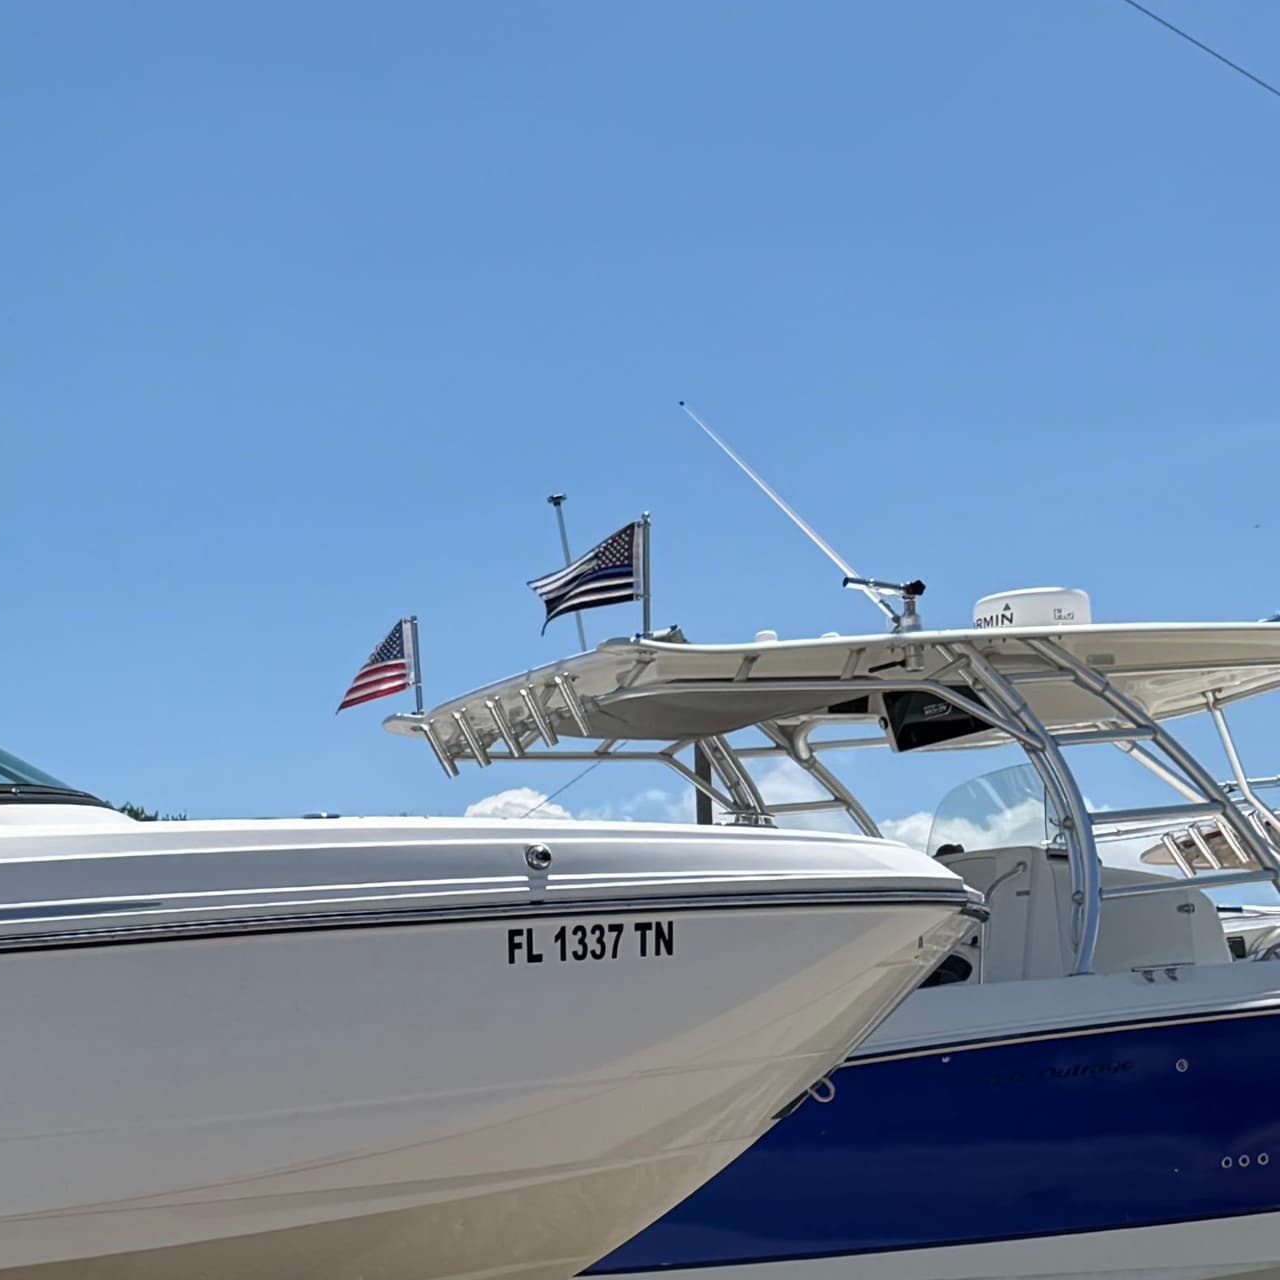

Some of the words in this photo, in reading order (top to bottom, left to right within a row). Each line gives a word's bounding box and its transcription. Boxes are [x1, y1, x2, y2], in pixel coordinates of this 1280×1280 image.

[973, 612, 1014, 629] RMIN
[508, 928, 543, 965] FL
[554, 923, 624, 962] 1337
[634, 920, 674, 957] TN
